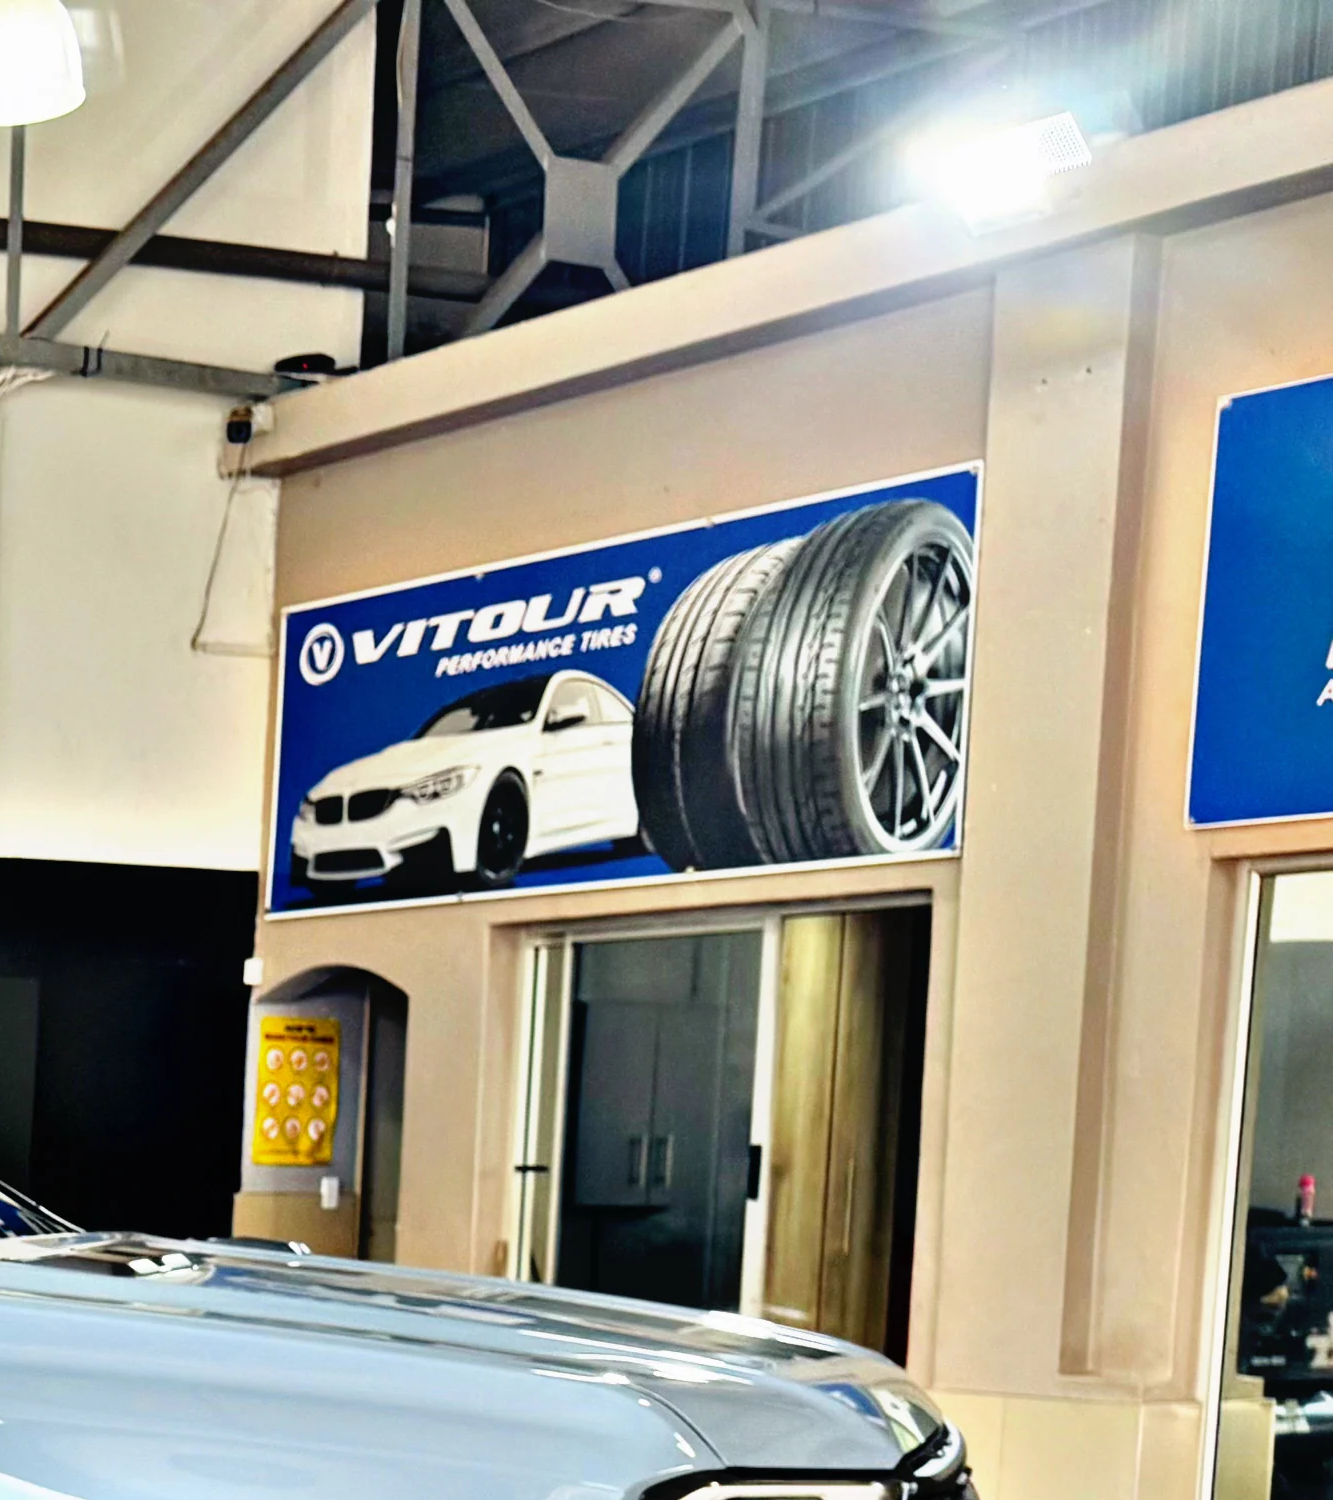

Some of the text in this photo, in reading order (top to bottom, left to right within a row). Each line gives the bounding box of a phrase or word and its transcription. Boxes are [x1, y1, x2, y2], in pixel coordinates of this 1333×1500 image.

[351, 576, 647, 666] VITOUR
[435, 623, 638, 678] PERFORMANCE TIRES
